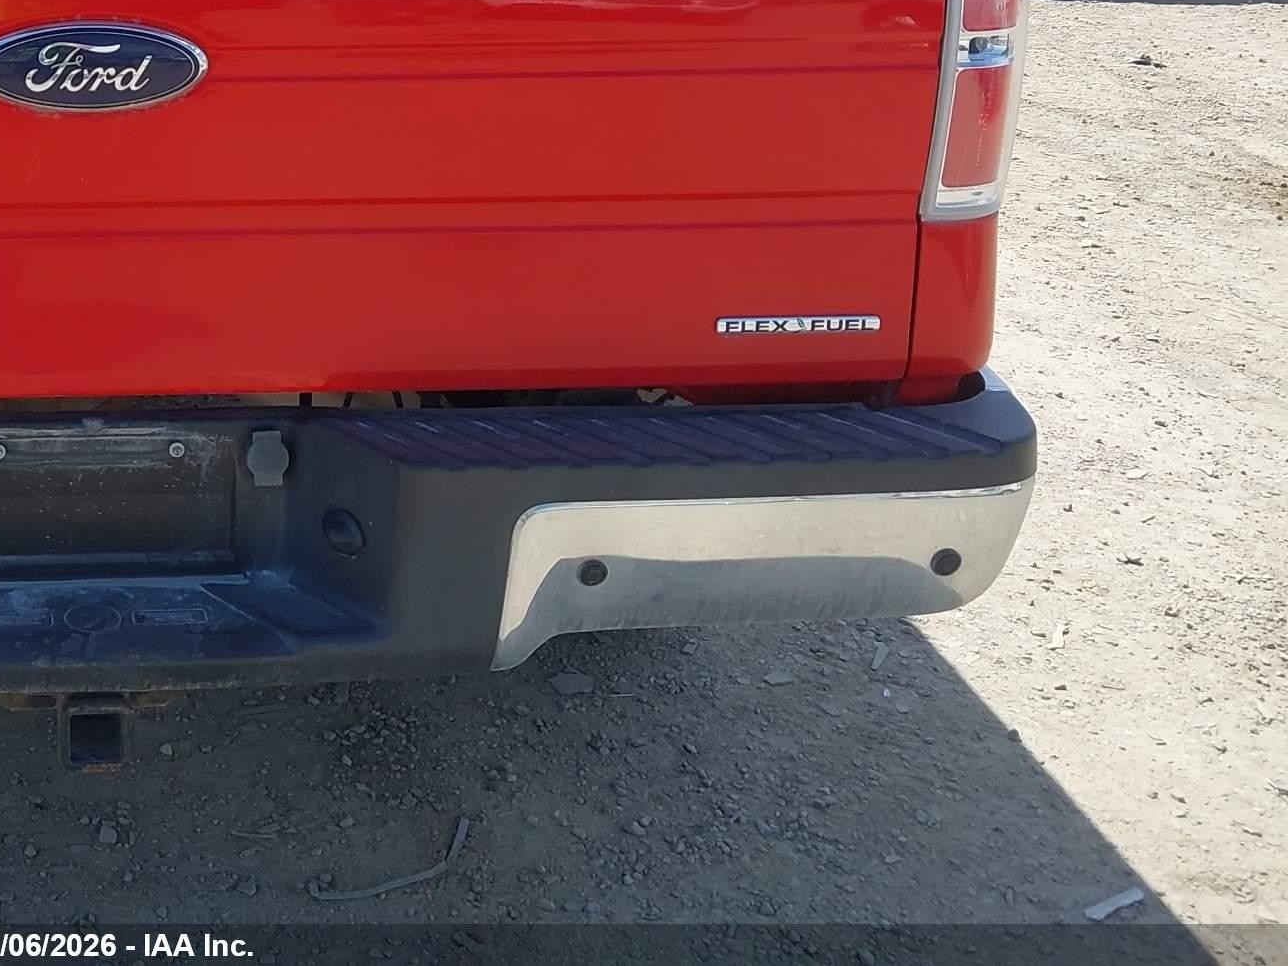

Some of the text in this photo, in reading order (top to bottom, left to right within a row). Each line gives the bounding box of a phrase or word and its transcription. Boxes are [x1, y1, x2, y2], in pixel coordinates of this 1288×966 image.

[25, 41, 153, 92] Ford
[724, 319, 875, 333] FLEX FUEL
